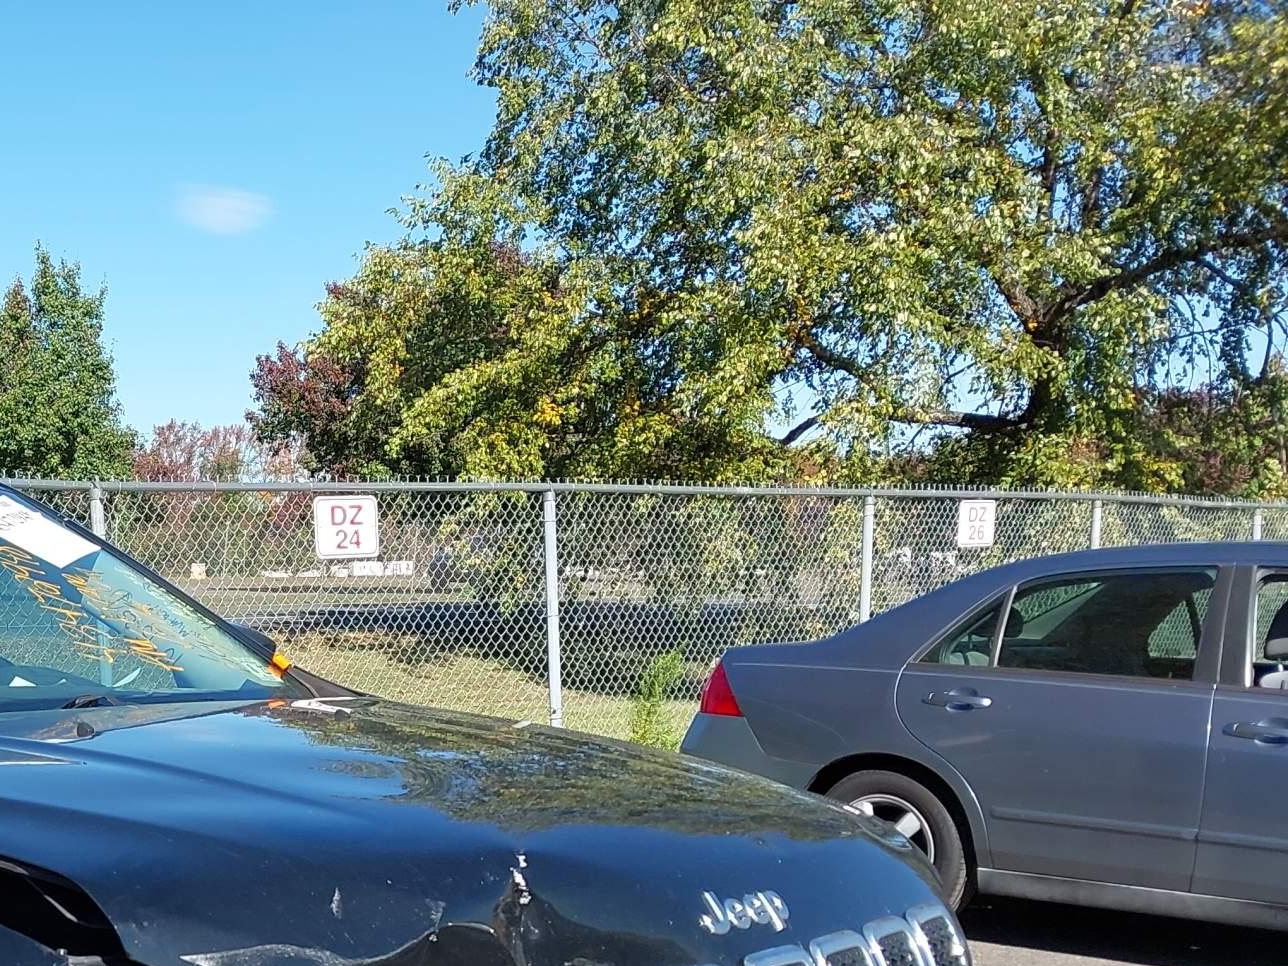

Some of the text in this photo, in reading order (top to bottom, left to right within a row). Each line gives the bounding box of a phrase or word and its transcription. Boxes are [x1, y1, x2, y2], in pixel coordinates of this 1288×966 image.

[330, 504, 363, 526] DZ
[968, 506, 987, 522] DZ
[335, 529, 362, 549] 24
[968, 525, 985, 540] 26
[698, 890, 790, 935] Jeep
